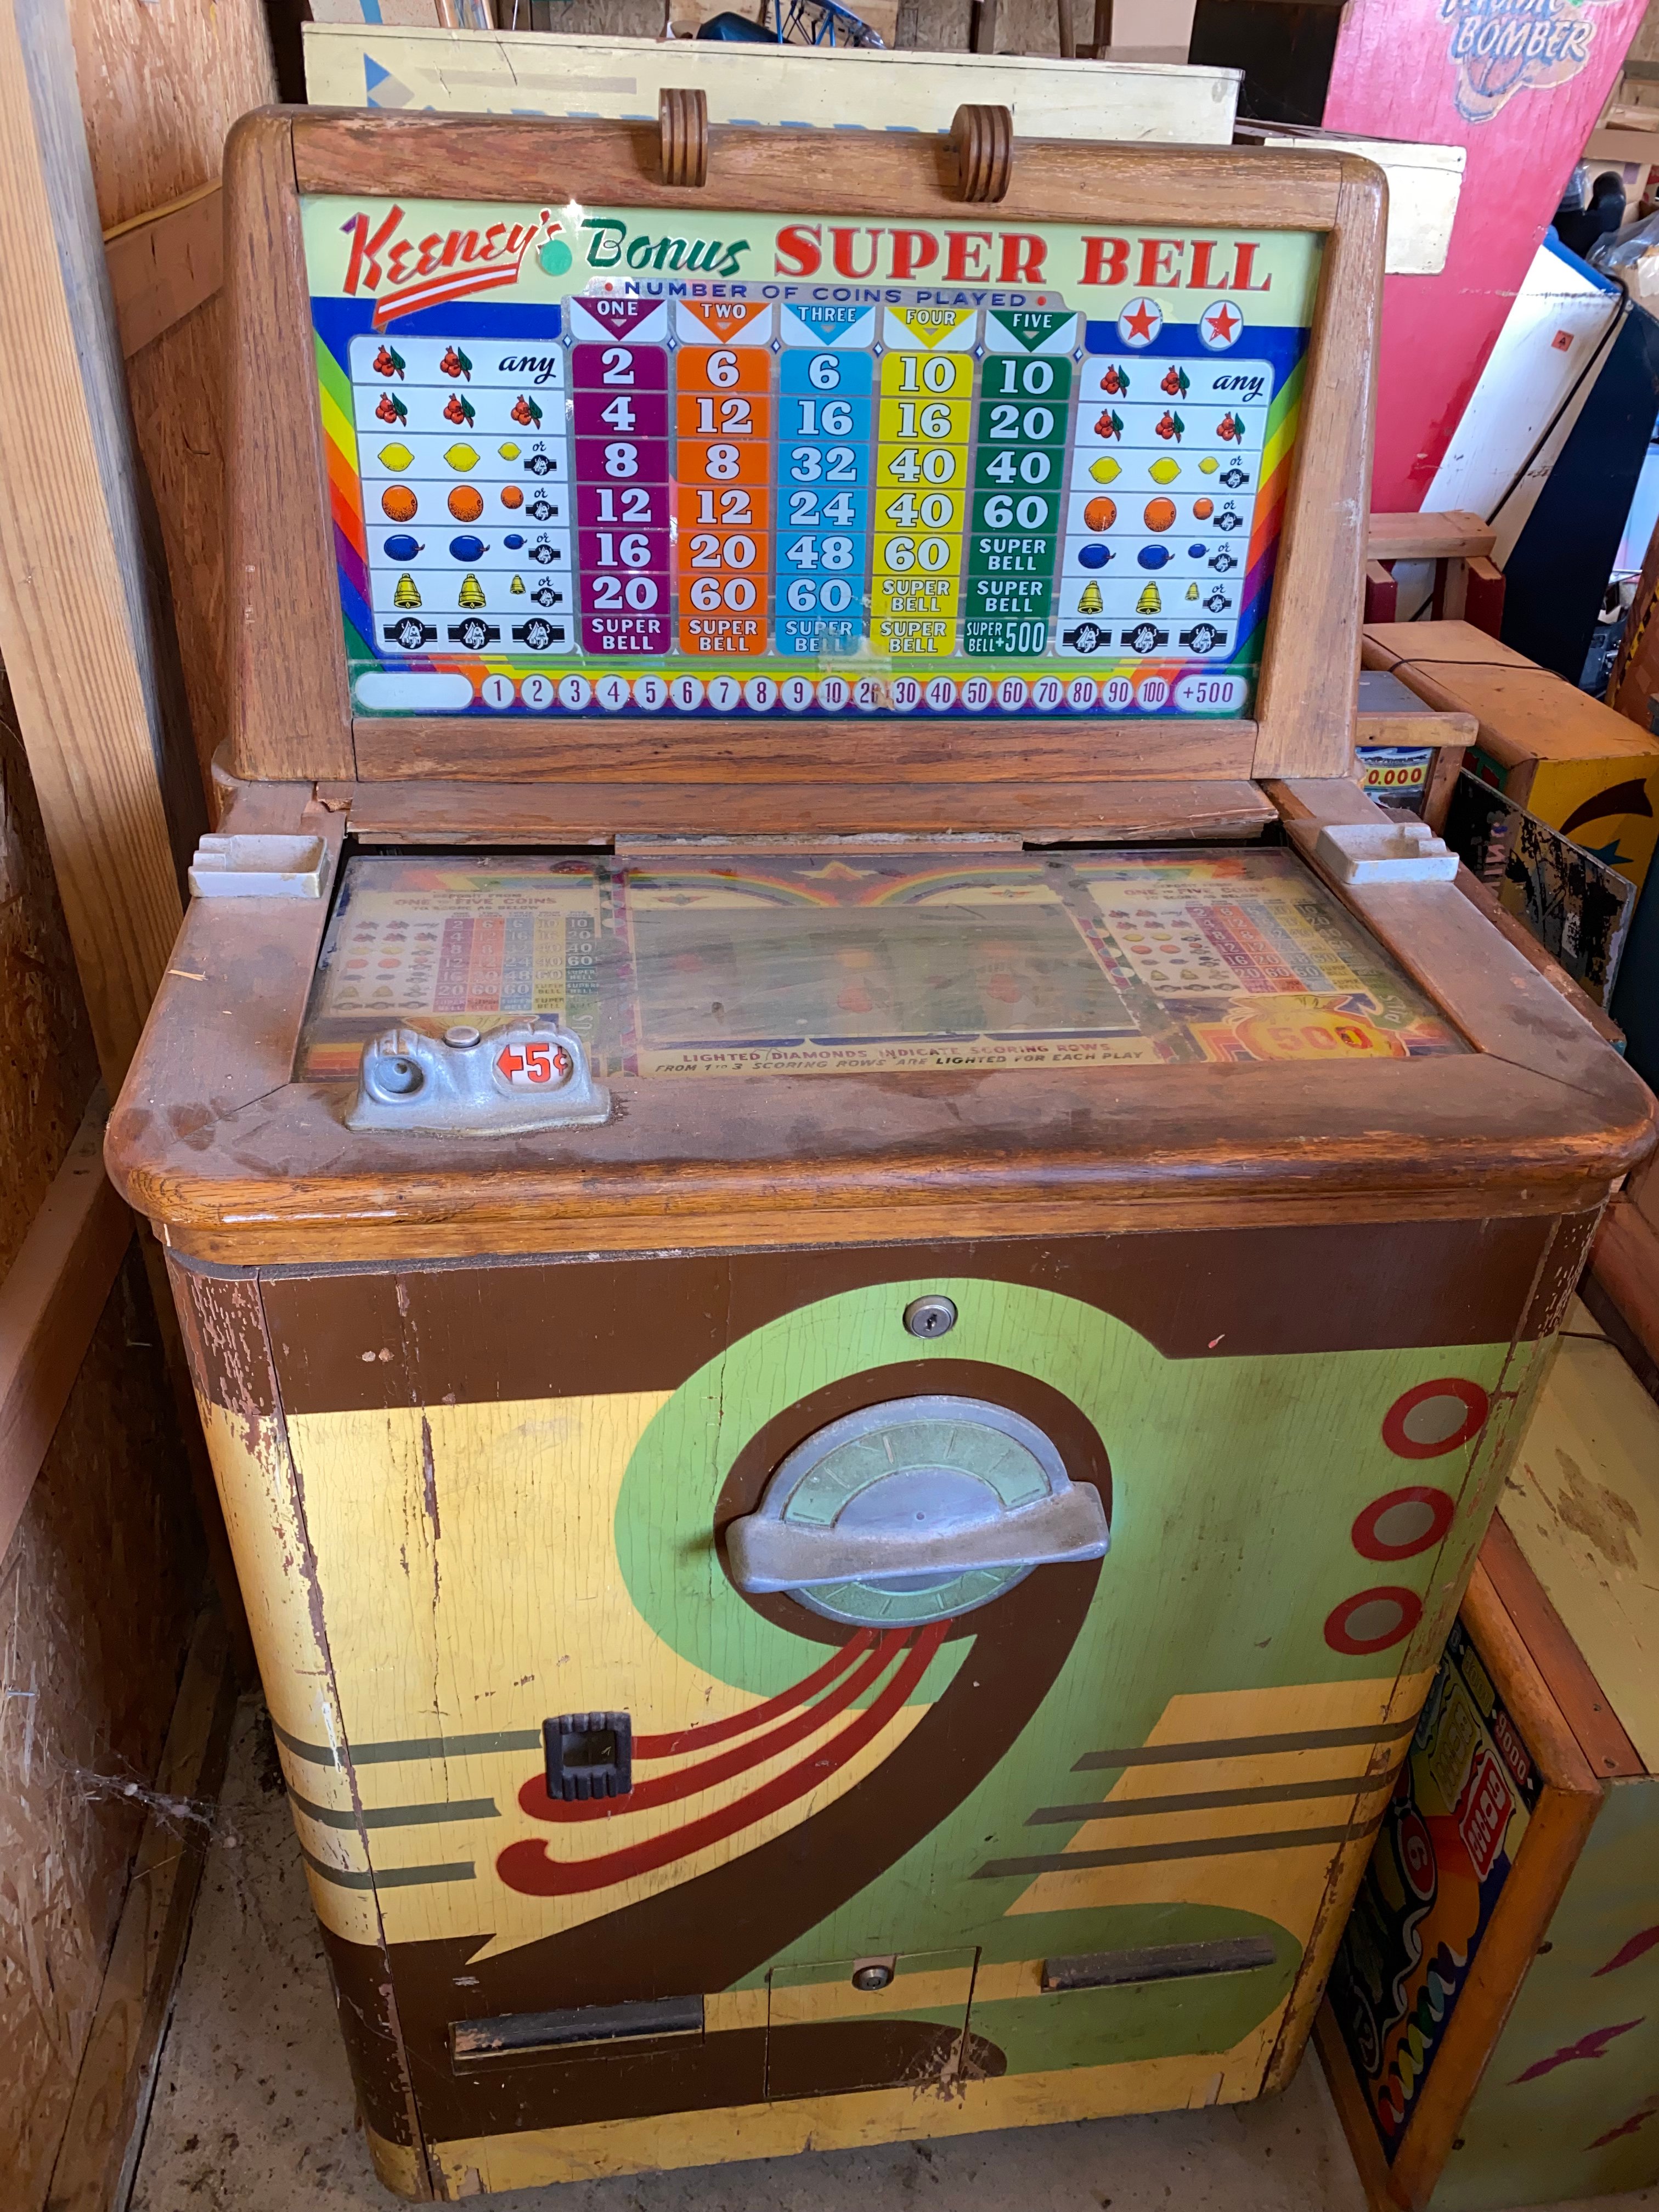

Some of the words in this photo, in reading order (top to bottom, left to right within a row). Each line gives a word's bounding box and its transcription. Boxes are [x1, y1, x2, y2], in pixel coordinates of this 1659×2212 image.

[1457, 16, 1592, 60] BOMBER
[580, 218, 753, 276] Bonus
[772, 223, 1047, 285] SUPER
[1079, 236, 1272, 291] BELL
[625, 281, 747, 297] NUMBER
[761, 285, 799, 298] OF
[813, 287, 901, 302] COINS
[917, 290, 1026, 306] PLAYED
[597, 300, 638, 316] ONE
[701, 303, 746, 319] TWO
[798, 306, 856, 322] THREE
[906, 309, 956, 326] FOUR
[1013, 313, 1052, 328] FIVE
[498, 356, 556, 384] any
[601, 347, 635, 385] 2
[706, 349, 740, 388] 6
[809, 353, 841, 391] 6
[899, 356, 956, 393] 10
[1001, 359, 1054, 394] 10
[1213, 375, 1265, 402] any
[601, 396, 636, 431] 4
[696, 398, 753, 434] 12
[797, 400, 854, 436] 16
[897, 403, 951, 438] 16
[990, 405, 1054, 439] 20
[604, 442, 639, 477] 8
[705, 443, 740, 481] 8
[790, 447, 857, 482] 32
[889, 448, 956, 484] 40
[986, 450, 1051, 484] 40
[596, 488, 651, 523] 12
[696, 489, 752, 524] 12
[789, 490, 855, 526] 24
[885, 493, 953, 527] 40
[984, 495, 1048, 529] 60
[596, 533, 651, 568] 16
[689, 535, 756, 569] 20
[787, 535, 854, 571] 48
[884, 536, 951, 572] 60
[979, 539, 1046, 555] SUPER
[988, 555, 1036, 571] BELL
[591, 575, 658, 610] 20
[690, 577, 757, 613] 60
[787, 578, 853, 613] 60
[882, 580, 950, 596] SUPER
[977, 580, 1042, 596] SUPER
[892, 596, 940, 612] BELL
[986, 596, 1033, 612] BELL
[591, 618, 661, 634] SUPER
[689, 619, 758, 636] SUPER
[786, 620, 853, 635] SUPER
[881, 621, 946, 637] SUPER
[967, 622, 1002, 636] SUPER
[602, 635, 653, 651] BELL
[700, 636, 749, 653] BELL
[795, 637, 844, 652] BELL
[888, 637, 938, 653] BELL
[968, 638, 995, 652] BELL
[494, 680, 502, 702] 1
[532, 680, 543, 702] 2
[570, 680, 581, 702] 3
[607, 681, 620, 703] 4
[646, 681, 656, 703] 5
[682, 682, 692, 703] 6
[720, 682, 730, 703] 7
[757, 682, 768, 703] 8
[793, 682, 804, 703] 9
[825, 682, 842, 703] 10
[896, 682, 916, 704] 30
[931, 682, 952, 703] 40
[967, 682, 988, 703] 50
[1002, 682, 1023, 703] 60
[1039, 682, 1058, 703] 70
[1073, 682, 1092, 702] 80
[1108, 682, 1128, 703] 90
[1143, 682, 1165, 703] 100
[1183, 682, 1233, 703] +500
[455, 898, 493, 906] FIVE
[1266, 1025, 1373, 1051] 500
[656, 1064, 697, 1073] FROM
[732, 1062, 743, 1071] 3
[752, 1060, 829, 1070] SCORING
[836, 1059, 887, 1068] ROWS
[896, 1057, 928, 1066] ARE
[936, 1056, 1007, 1065] LIGHTED
[1015, 1054, 1046, 1063] FOR
[1052, 1052, 1096, 1062] EACH
[1102, 1051, 1143, 1060] PLAY
[683, 1053, 761, 1063] LIGHTED
[771, 1050, 868, 1060] DIAMONDS
[880, 1047, 960, 1058] INDICATE
[971, 1043, 1049, 1054] SCORING
